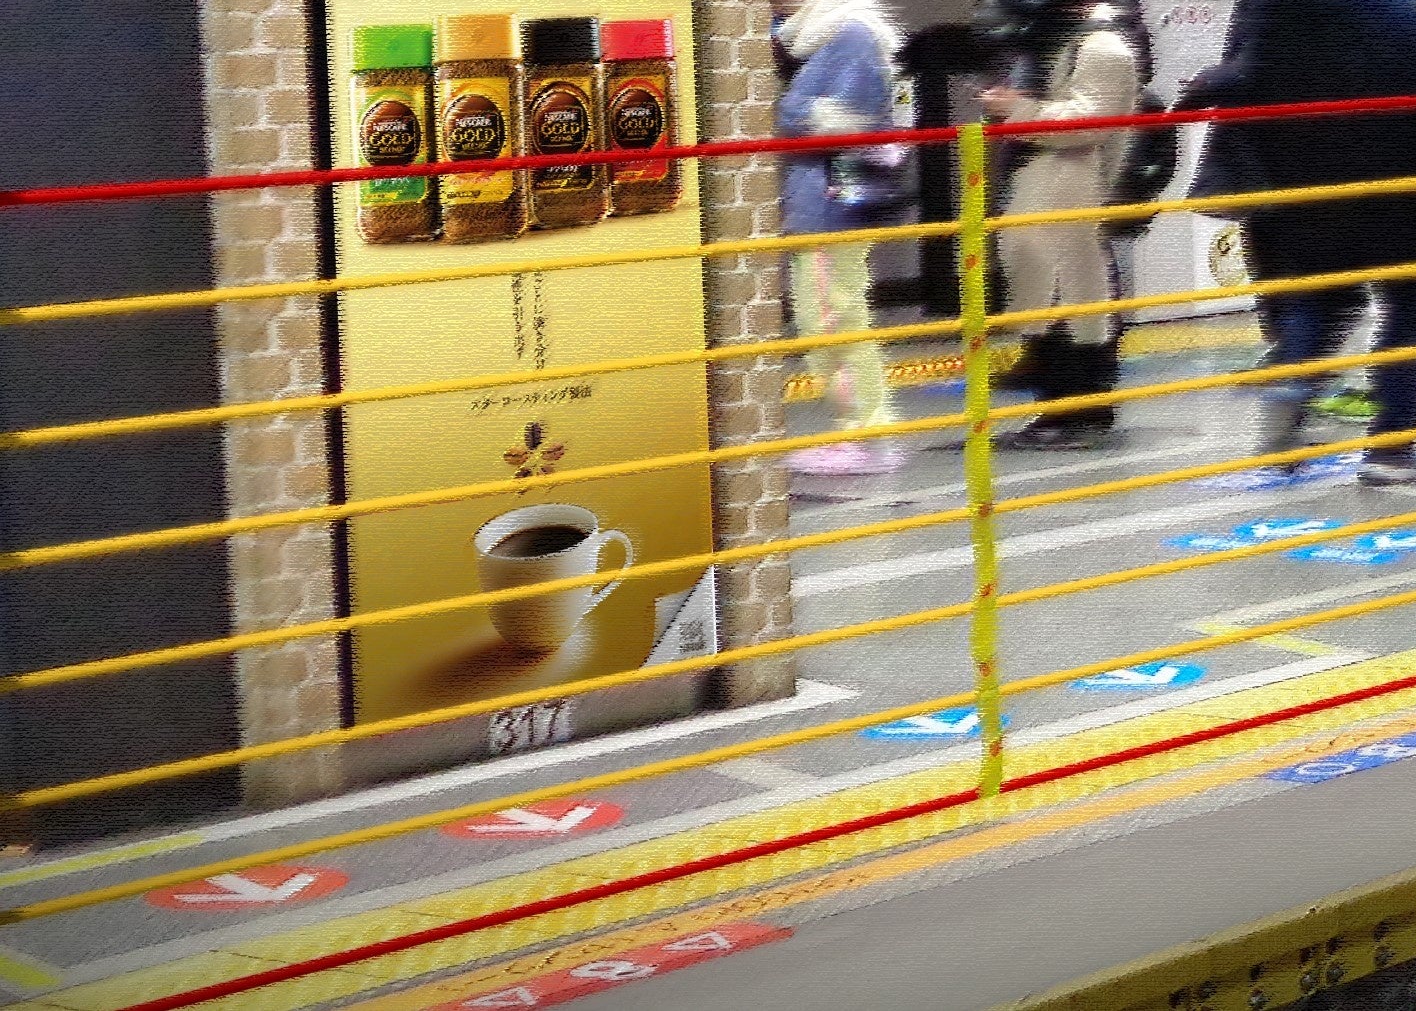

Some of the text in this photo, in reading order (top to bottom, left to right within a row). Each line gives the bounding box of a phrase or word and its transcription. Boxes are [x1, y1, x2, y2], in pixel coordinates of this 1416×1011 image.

[369, 132, 412, 147] GOLD
[451, 128, 497, 143] GOLD
[494, 698, 568, 752] 317
